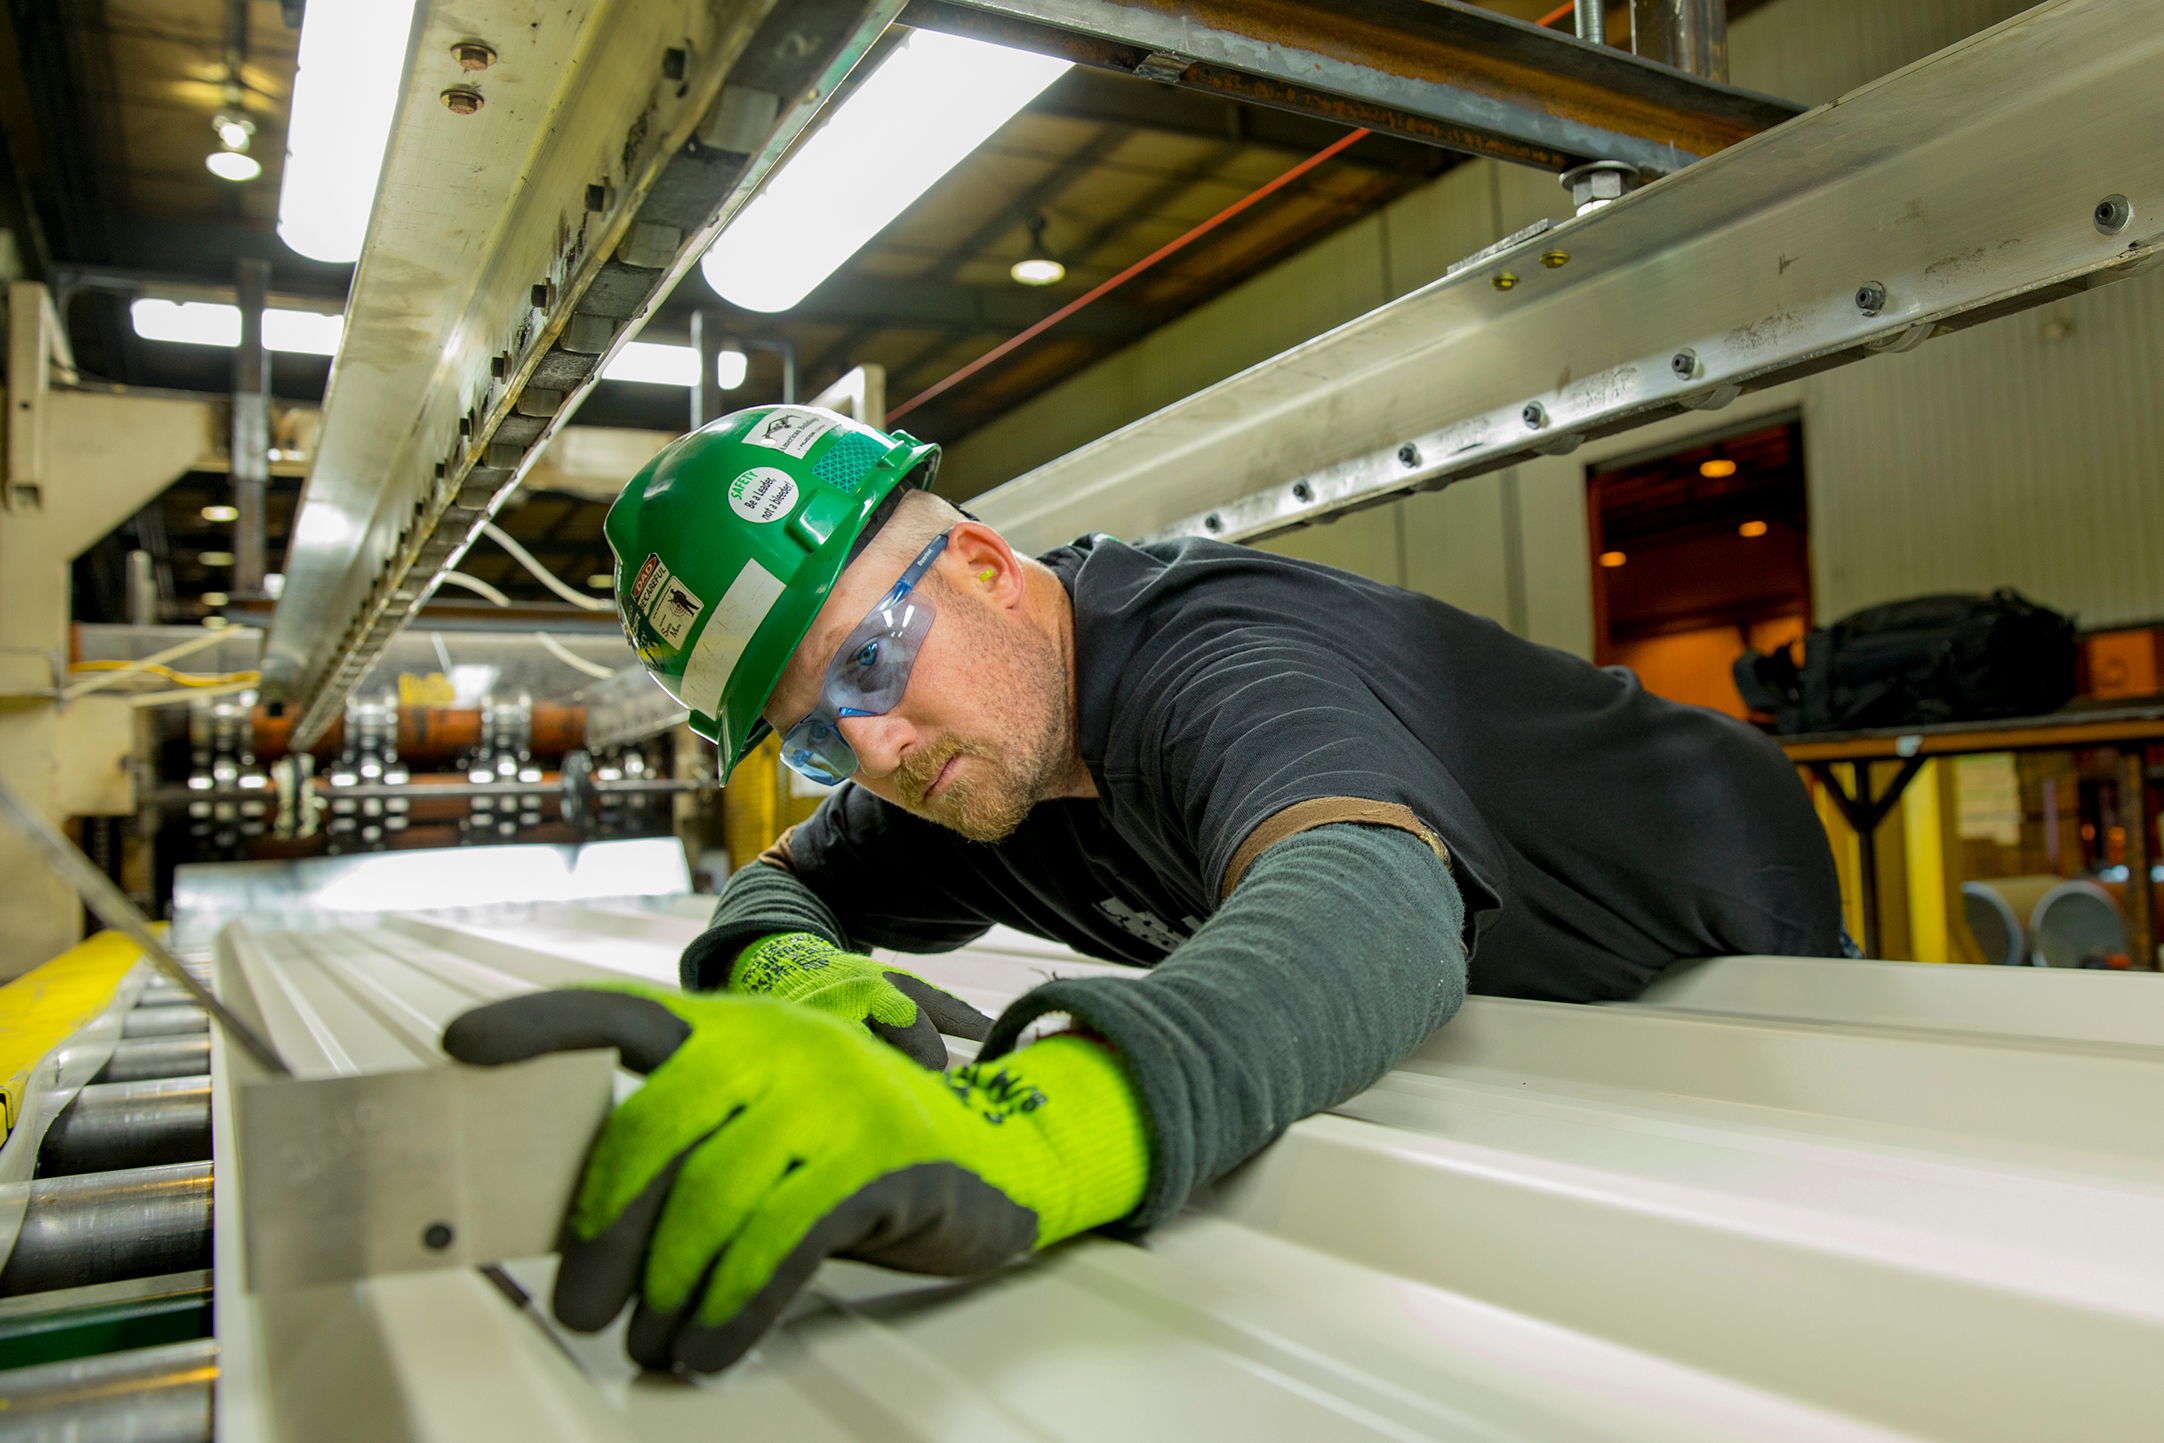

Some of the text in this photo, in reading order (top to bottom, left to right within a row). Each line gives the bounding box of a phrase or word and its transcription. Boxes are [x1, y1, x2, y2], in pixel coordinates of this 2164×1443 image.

[730, 471, 758, 500] SAFETY
[744, 500, 758, 509] Be
[753, 477, 777, 496] Leader,
[761, 507, 775, 521] not
[769, 481, 794, 505] bleeder!
[635, 564, 653, 592] DAD
[644, 566, 666, 605] CAREFUL
